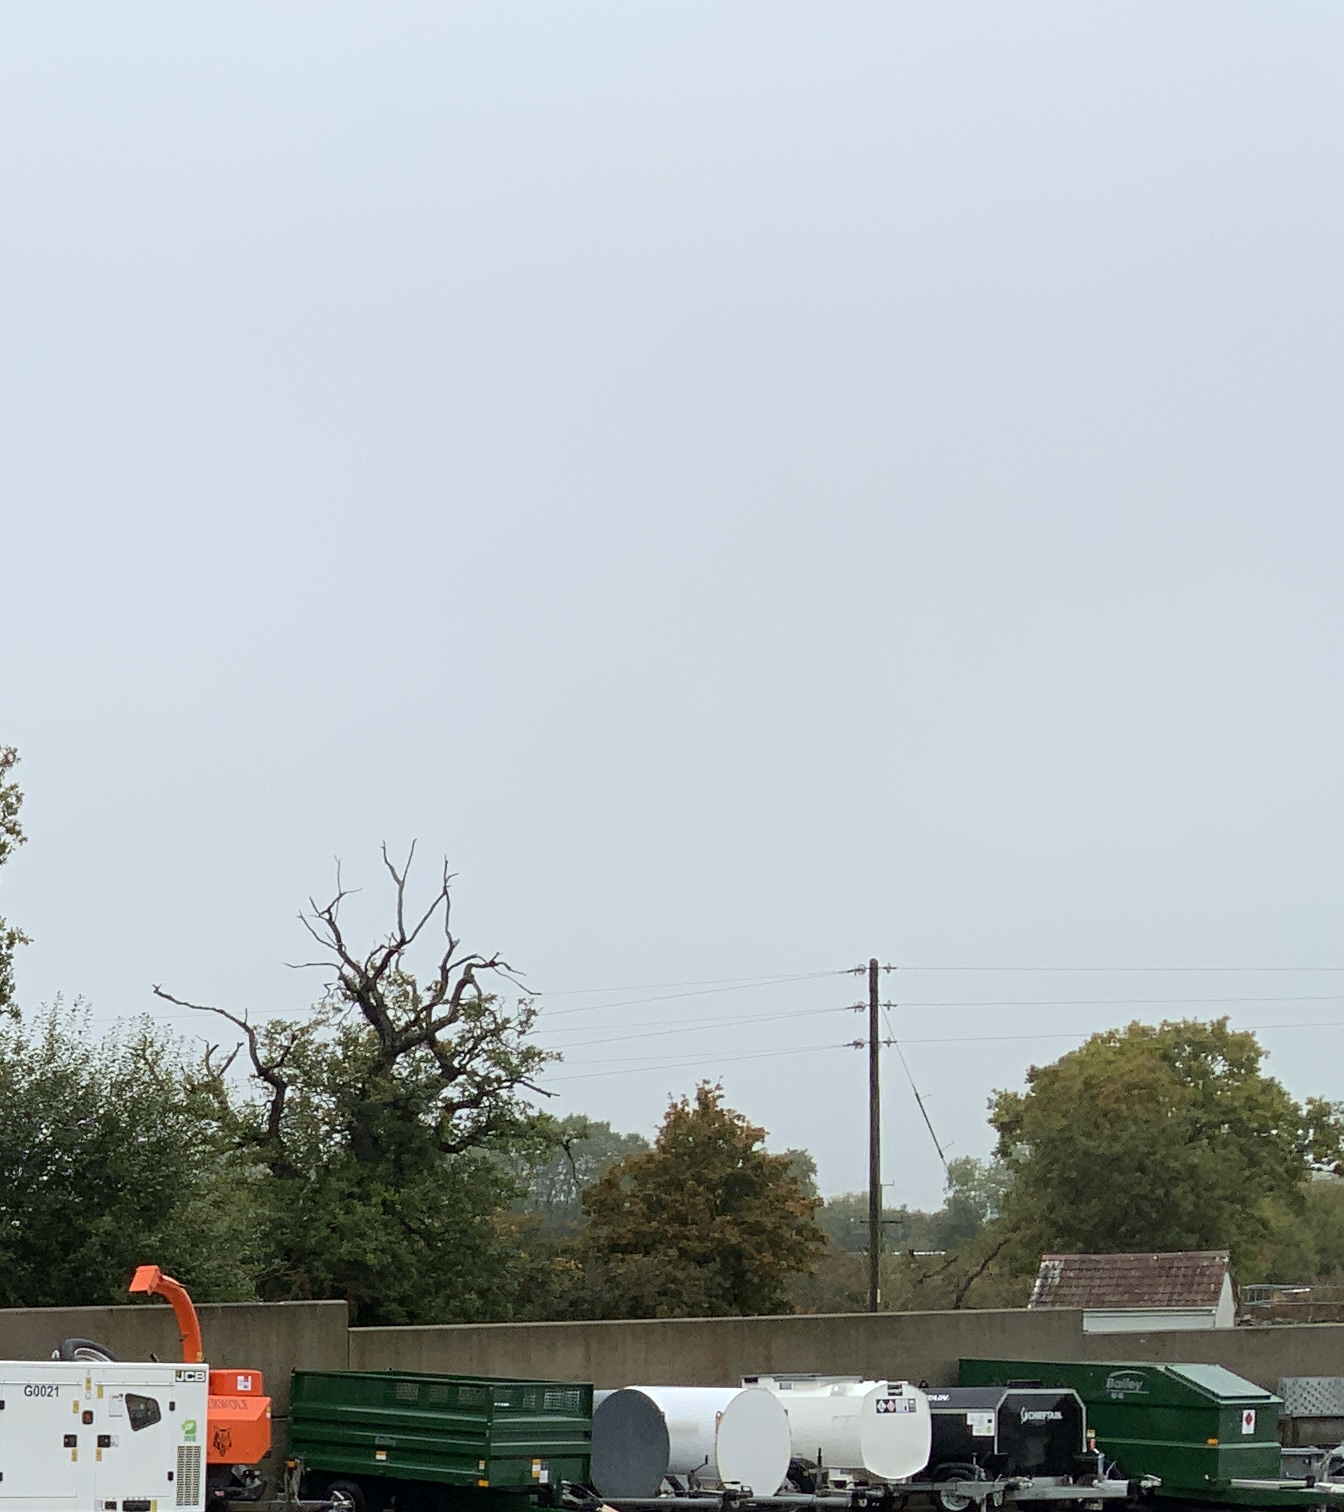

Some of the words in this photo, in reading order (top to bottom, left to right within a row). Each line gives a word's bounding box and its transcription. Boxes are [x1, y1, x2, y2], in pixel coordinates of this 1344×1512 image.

[175, 1370, 206, 1382] JCB
[1106, 1377, 1144, 1391] Bailey
[24, 1385, 59, 1397] G0021
